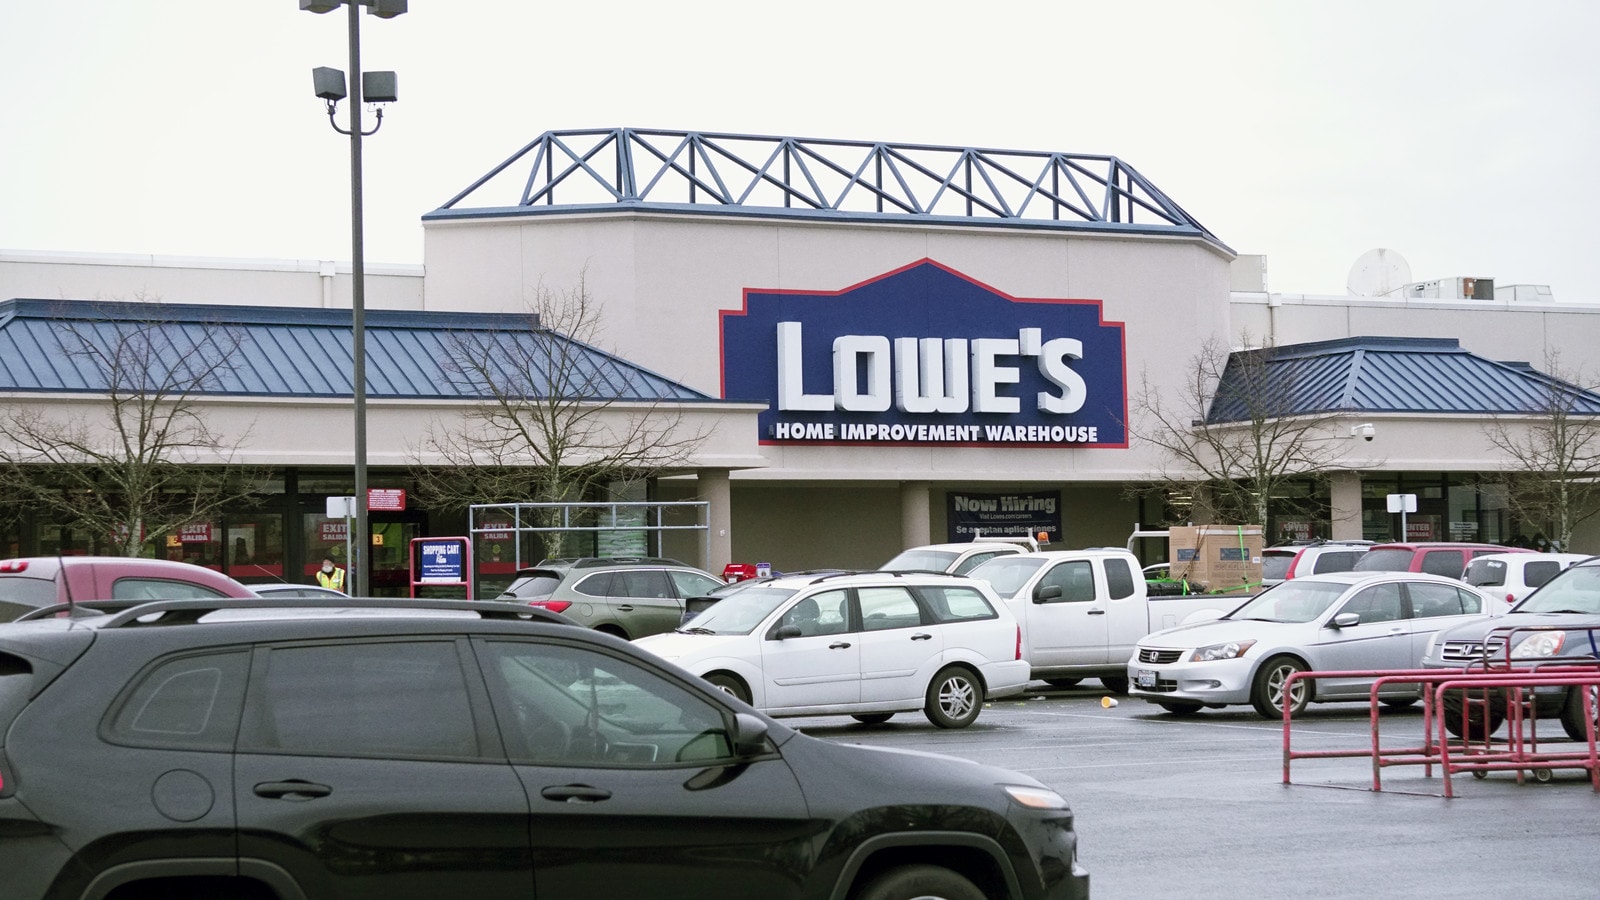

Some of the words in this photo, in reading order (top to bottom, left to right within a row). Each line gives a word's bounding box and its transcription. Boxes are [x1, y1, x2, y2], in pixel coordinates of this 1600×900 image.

[777, 321, 1087, 414] LOWE'S
[776, 422, 834, 440] HOME
[840, 424, 980, 441] IMPROVEMENT
[984, 425, 1098, 442] WAREHOUSE
[955, 496, 997, 511] Now
[1001, 496, 1056, 513] Hiring
[182, 524, 207, 534] EXIT
[322, 524, 347, 533] EXIT
[956, 525, 967, 534] Se
[423, 545, 446, 555] SHOPPING
[447, 544, 459, 554] CART
